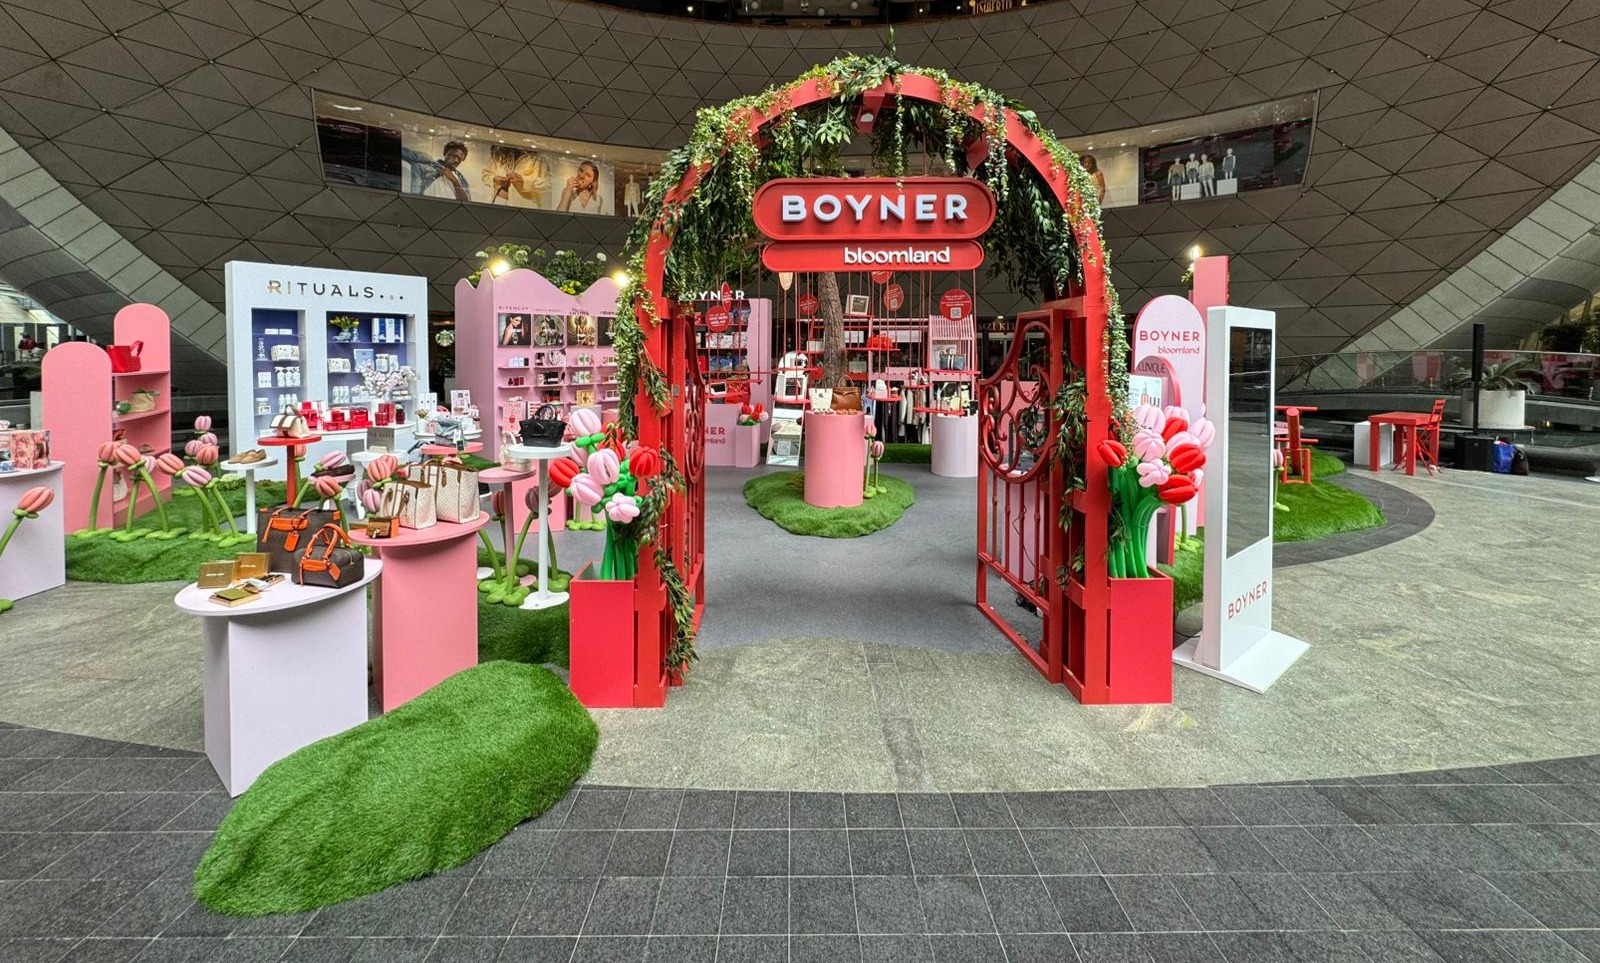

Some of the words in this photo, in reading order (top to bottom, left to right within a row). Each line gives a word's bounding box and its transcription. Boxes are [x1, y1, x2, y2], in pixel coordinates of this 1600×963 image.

[781, 194, 968, 222] BOYNER
[844, 246, 951, 265] bloomland
[1139, 330, 1200, 342] BOYNER
[1157, 346, 1200, 355] bloomland
[1227, 580, 1268, 619] BOYNER
